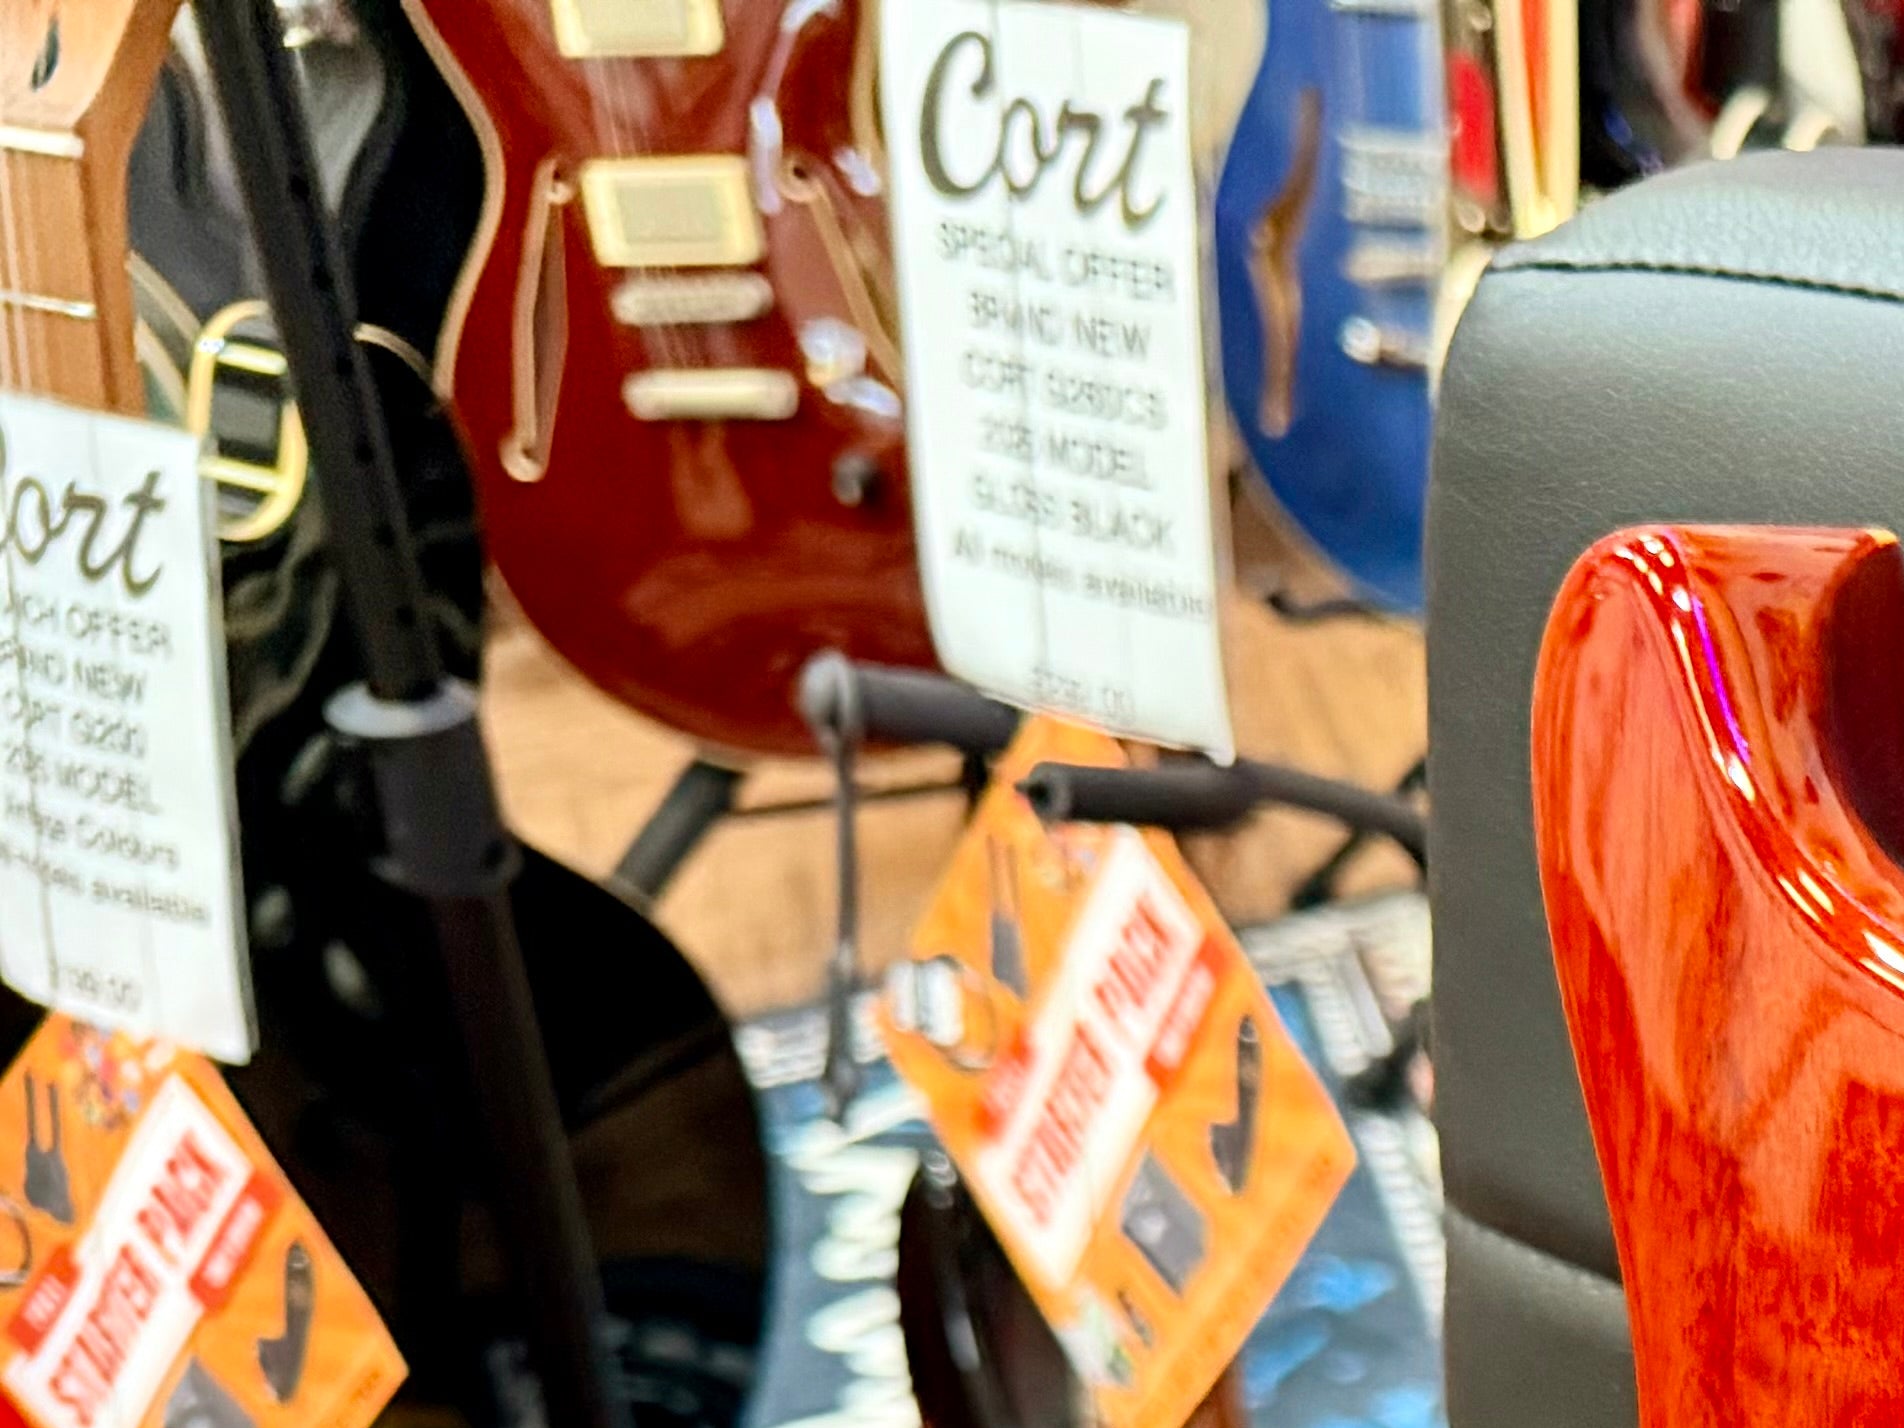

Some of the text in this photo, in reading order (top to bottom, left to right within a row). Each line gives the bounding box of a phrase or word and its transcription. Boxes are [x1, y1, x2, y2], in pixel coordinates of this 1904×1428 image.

[919, 30, 1168, 232] Cort
[1072, 314, 1149, 364] NEW
[0, 470, 164, 598] ort
